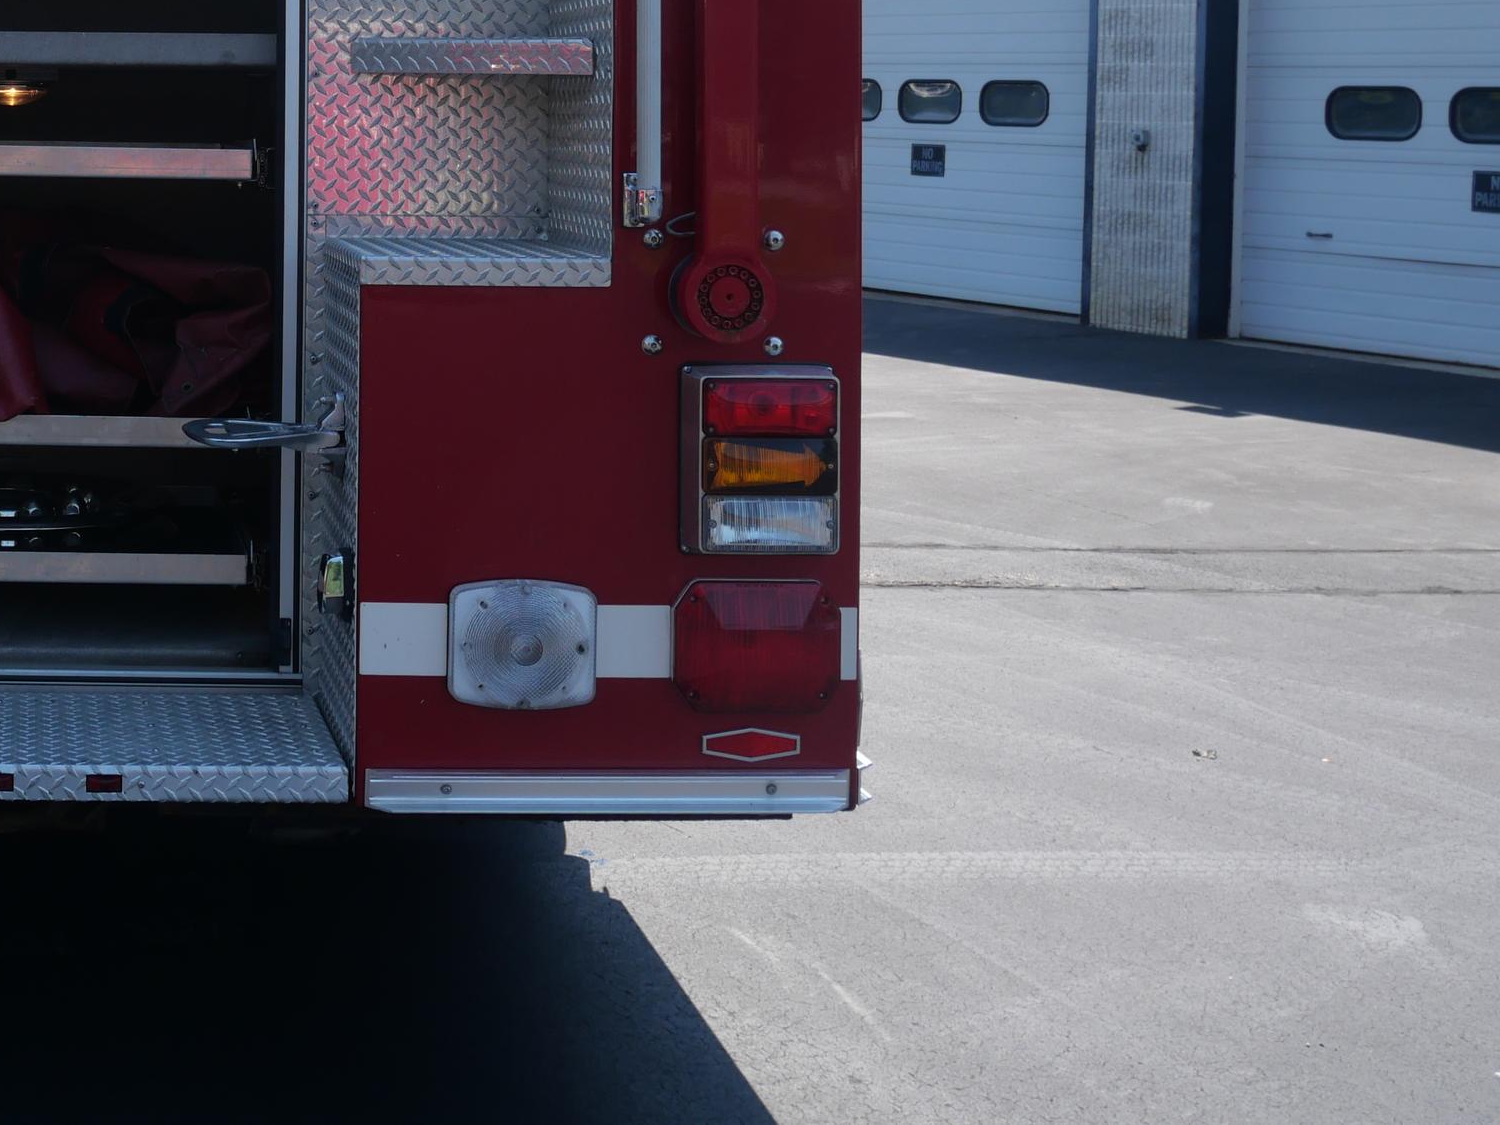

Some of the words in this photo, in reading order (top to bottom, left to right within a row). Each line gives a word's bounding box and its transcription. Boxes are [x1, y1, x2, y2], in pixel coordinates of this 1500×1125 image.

[922, 147, 934, 160] NO
[912, 160, 943, 173] PARKING
[1475, 191, 1500, 207] PAR
